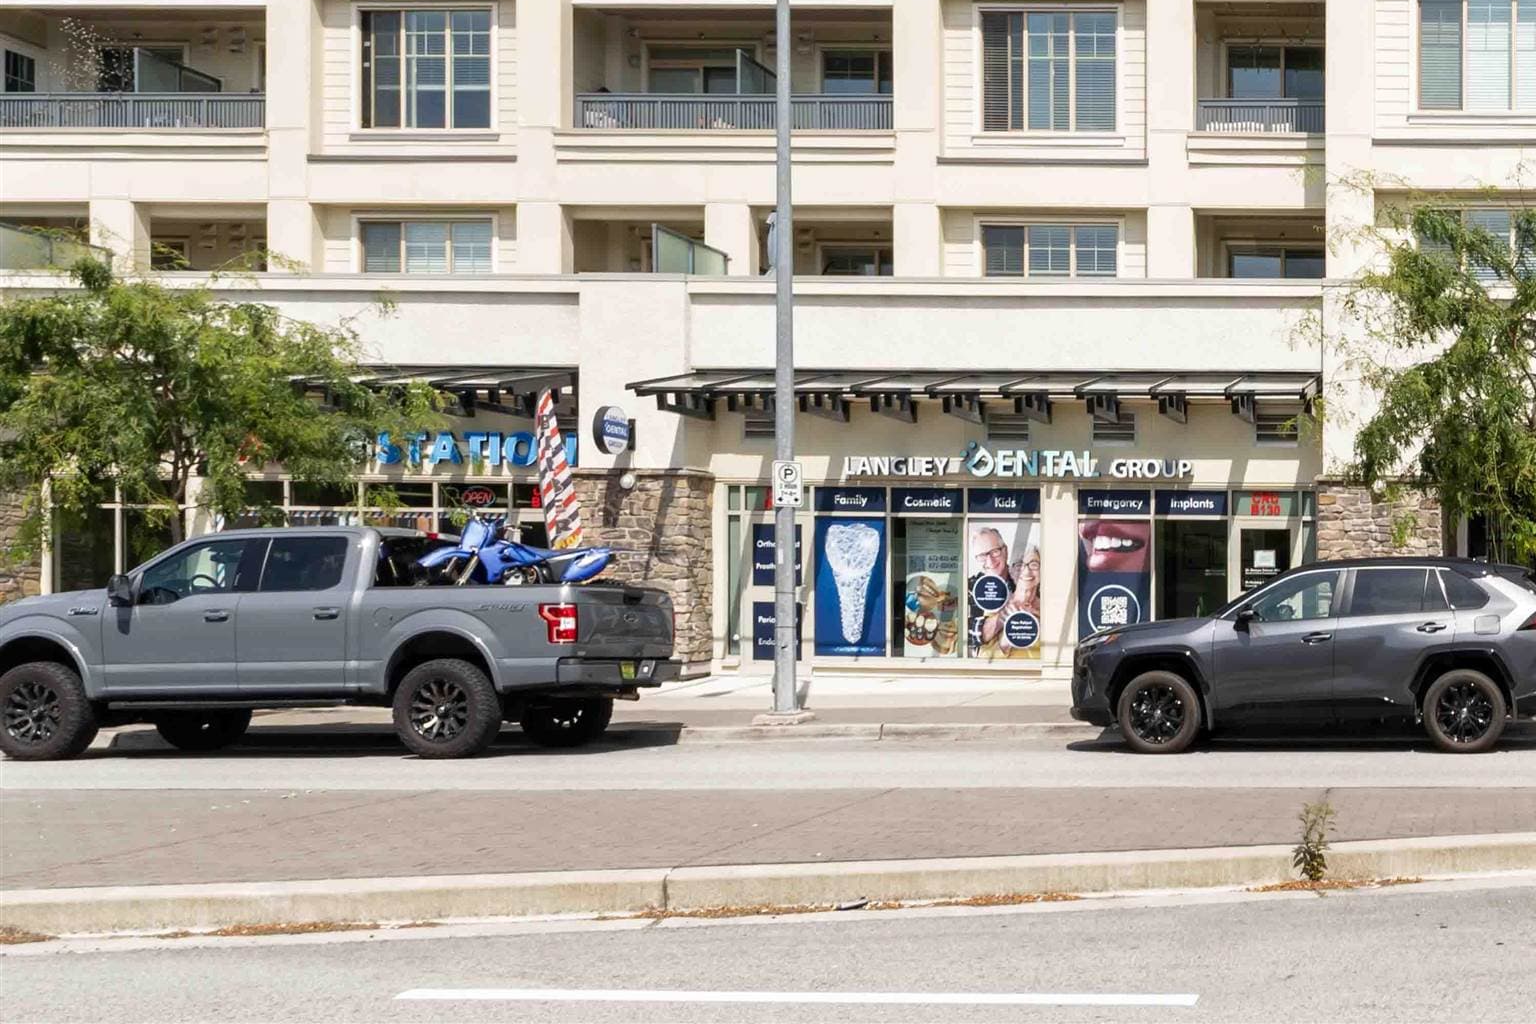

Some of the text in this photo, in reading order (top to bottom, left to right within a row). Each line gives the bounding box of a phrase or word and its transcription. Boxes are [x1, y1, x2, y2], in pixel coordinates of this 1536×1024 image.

[845, 445, 1193, 478] LANGLEY DENTAL GROUP
[784, 468, 794, 479] P
[463, 489, 493, 505] OPEN
[834, 494, 868, 508] Family
[904, 495, 952, 508] Cosmetic
[994, 496, 1017, 508] Kids
[1087, 497, 1143, 510] Emergency
[1170, 497, 1215, 511] Implants
